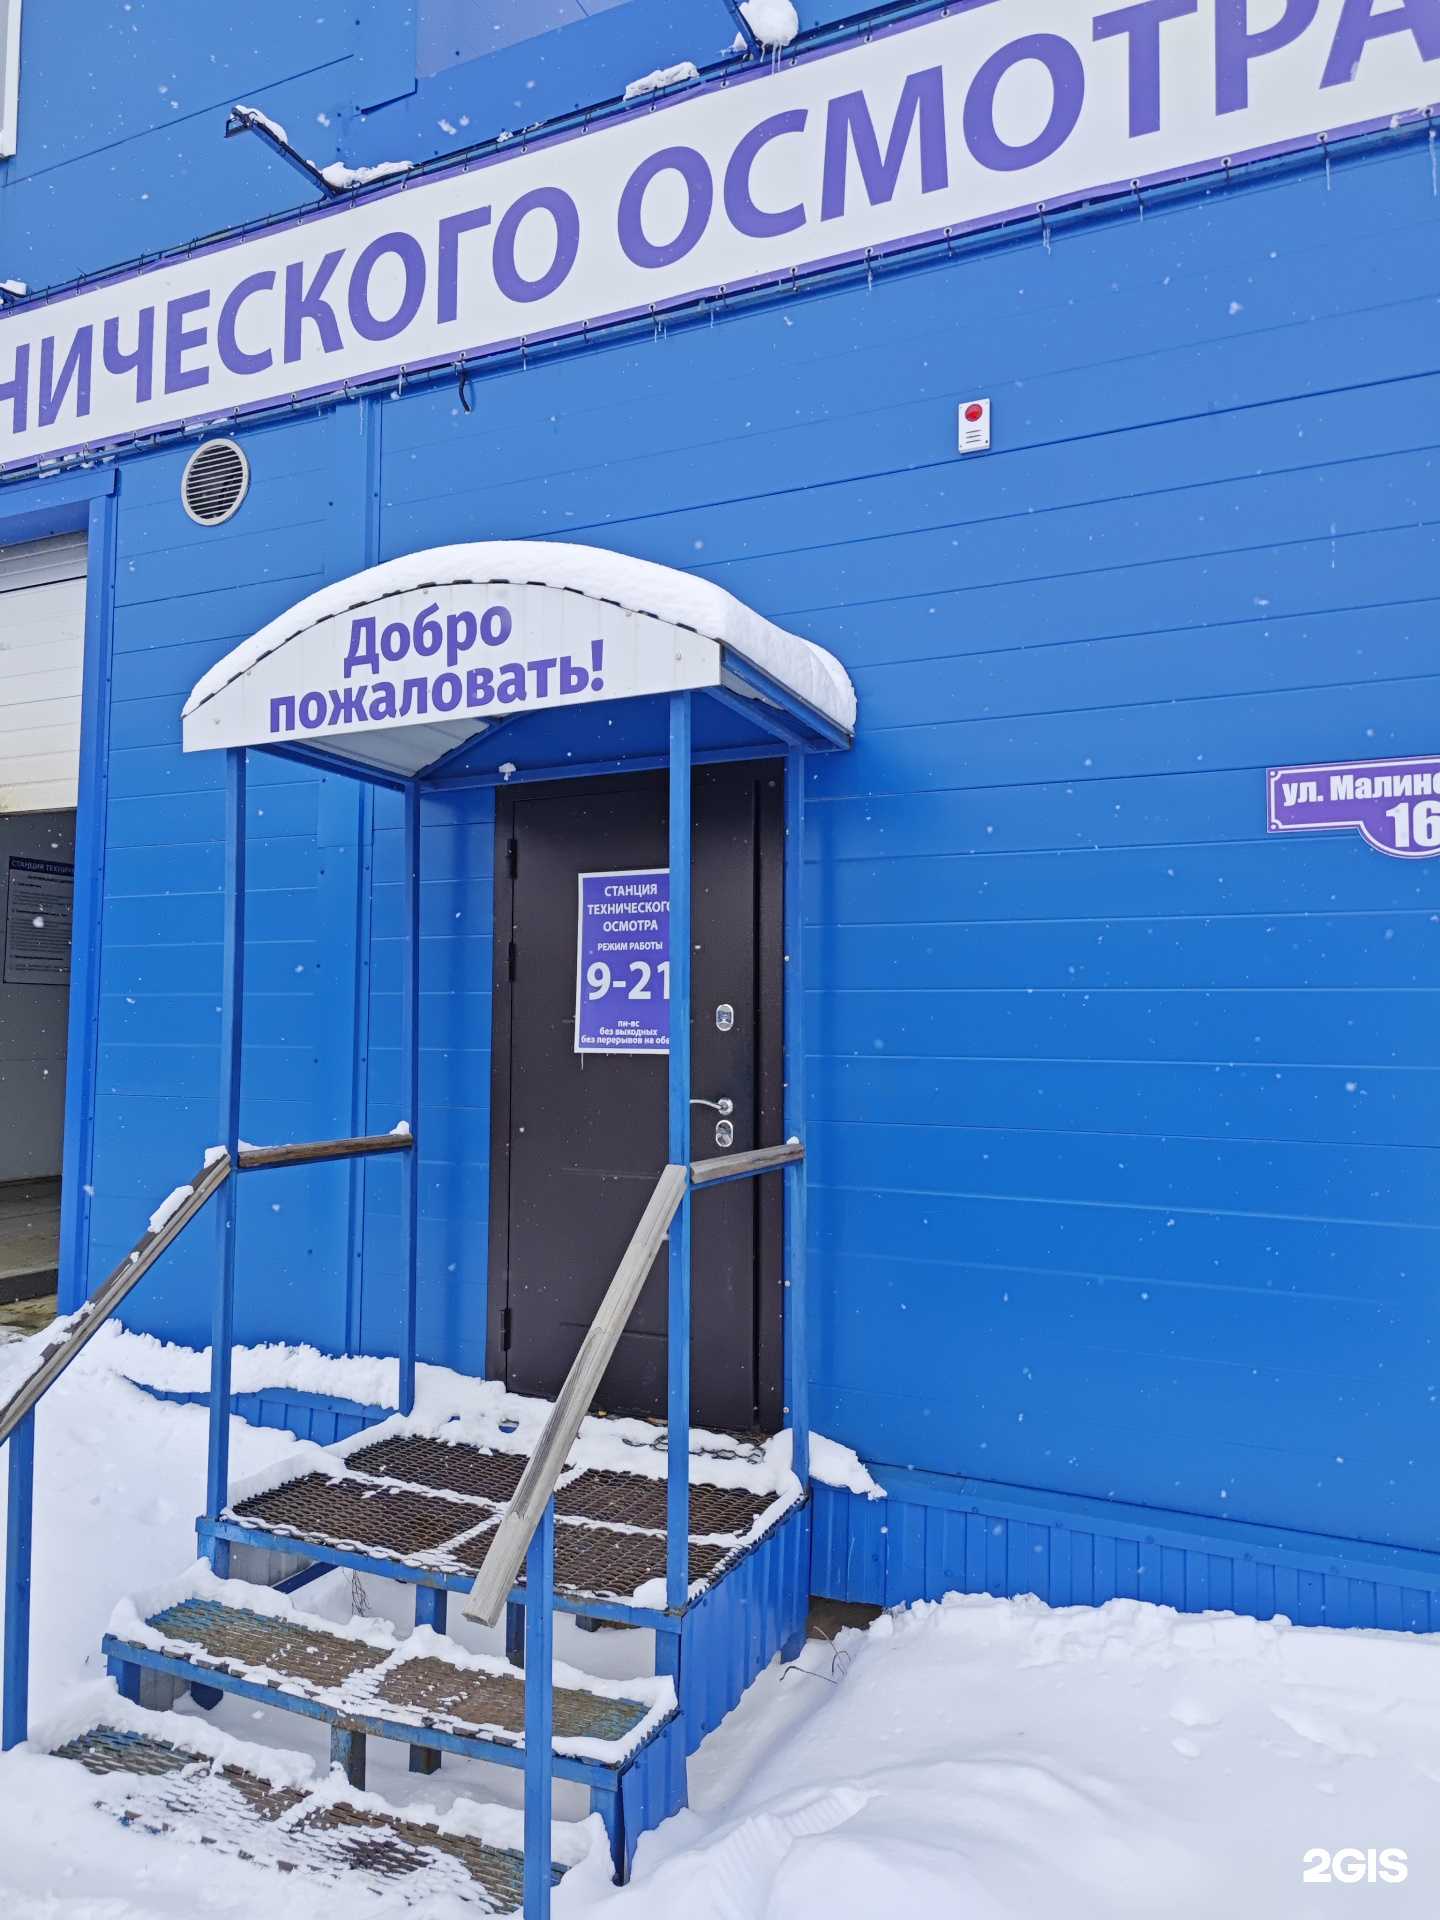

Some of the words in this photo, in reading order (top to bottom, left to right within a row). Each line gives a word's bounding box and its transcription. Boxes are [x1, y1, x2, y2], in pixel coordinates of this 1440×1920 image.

[617, 0, 1440, 269] ОСМОТРА
[344, 603, 512, 678] Добро
[270, 639, 604, 733] пожаловать!
[1282, 781, 1324, 807] ул.
[604, 884, 658, 897] СТАНЦИЯ
[603, 920, 658, 932] ОСМОТРА
[597, 942, 628, 951] РЕЖИМ
[629, 941, 663, 950] РАБОТЫ
[586, 961, 670, 1000] 9-21
[618, 1020, 640, 1028] пн-вс
[600, 1027, 613, 1035] без
[615, 1028, 658, 1037] выходных
[581, 1035, 595, 1044] без
[597, 1037, 642, 1046] перерывов
